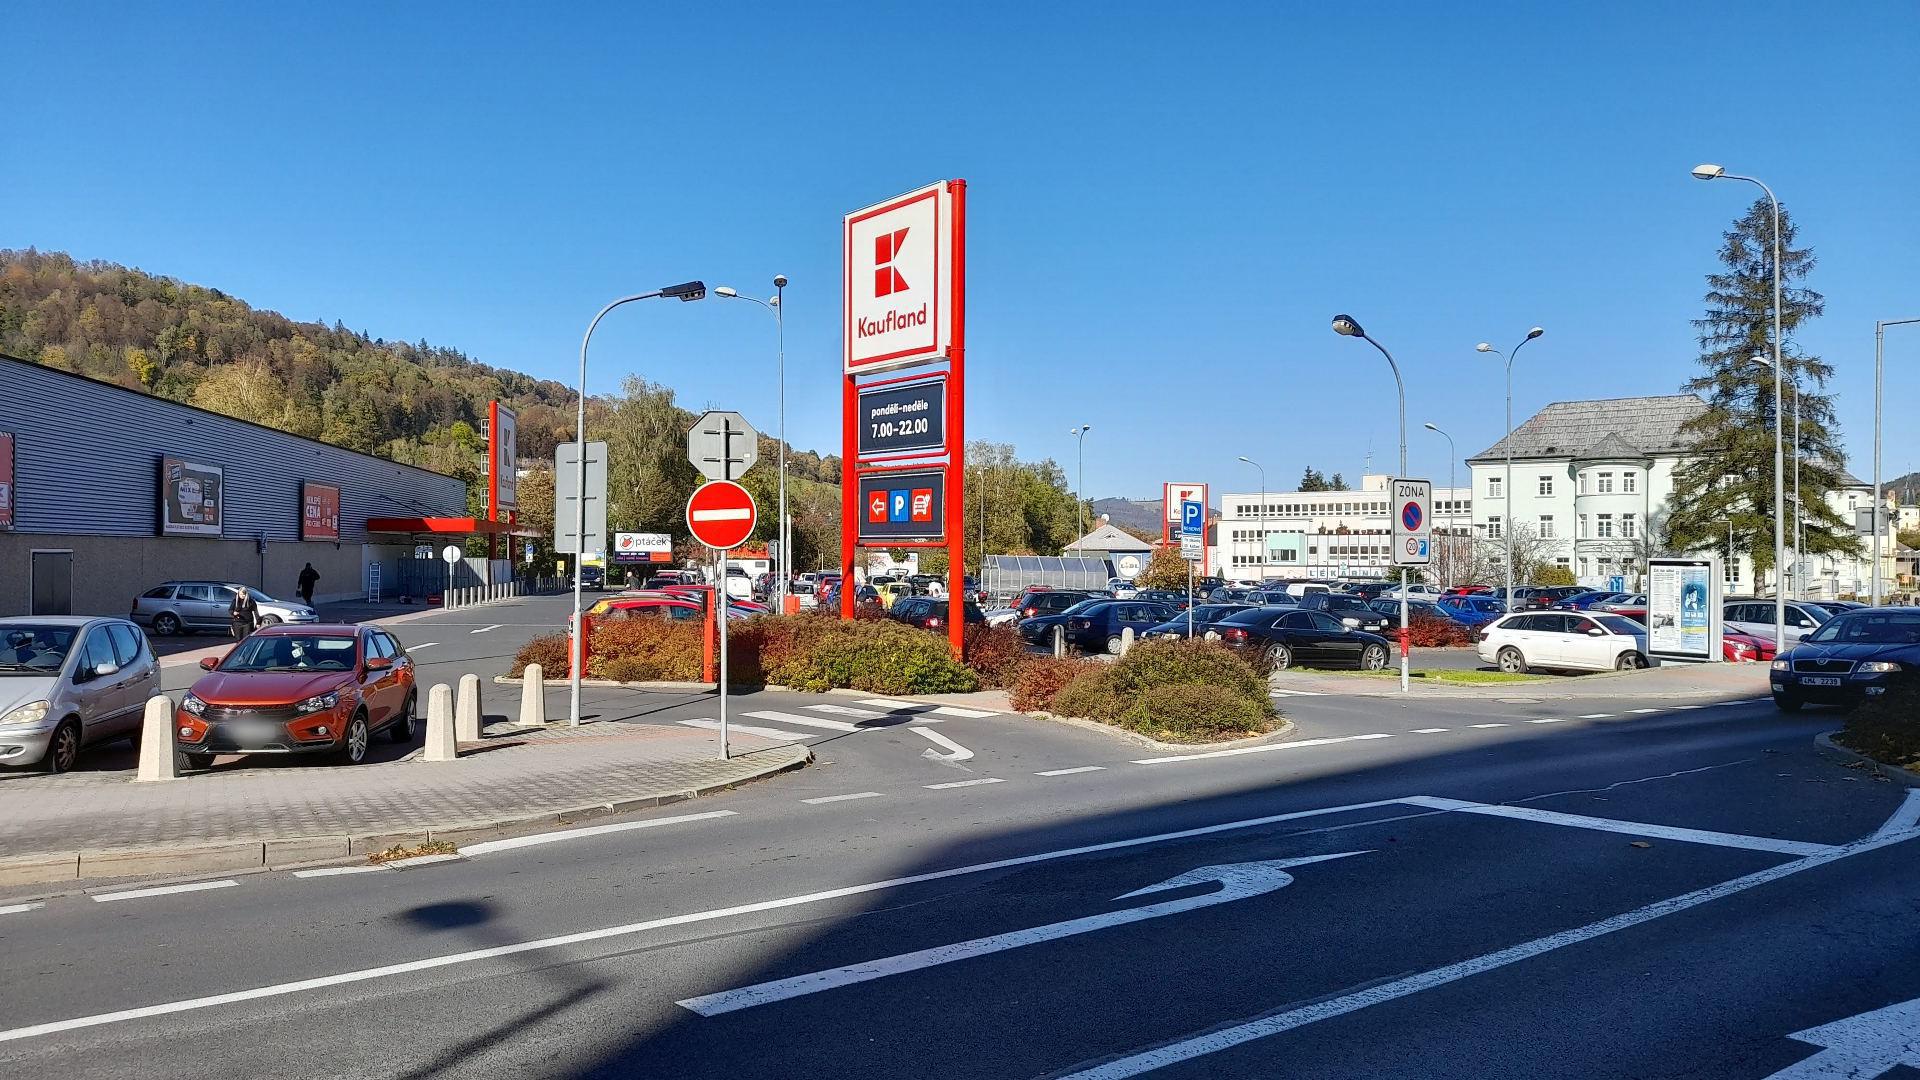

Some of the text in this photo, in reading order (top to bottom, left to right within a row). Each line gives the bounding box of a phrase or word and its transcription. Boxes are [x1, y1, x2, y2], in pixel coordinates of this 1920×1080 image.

[875, 226, 911, 298] K
[858, 302, 927, 339] Kaufland
[1399, 483, 1425, 497] ZÓNA
[895, 495, 904, 516] P
[1186, 505, 1199, 524] P
[635, 537, 667, 547] ptáček
[1408, 542, 1416, 551] 20
